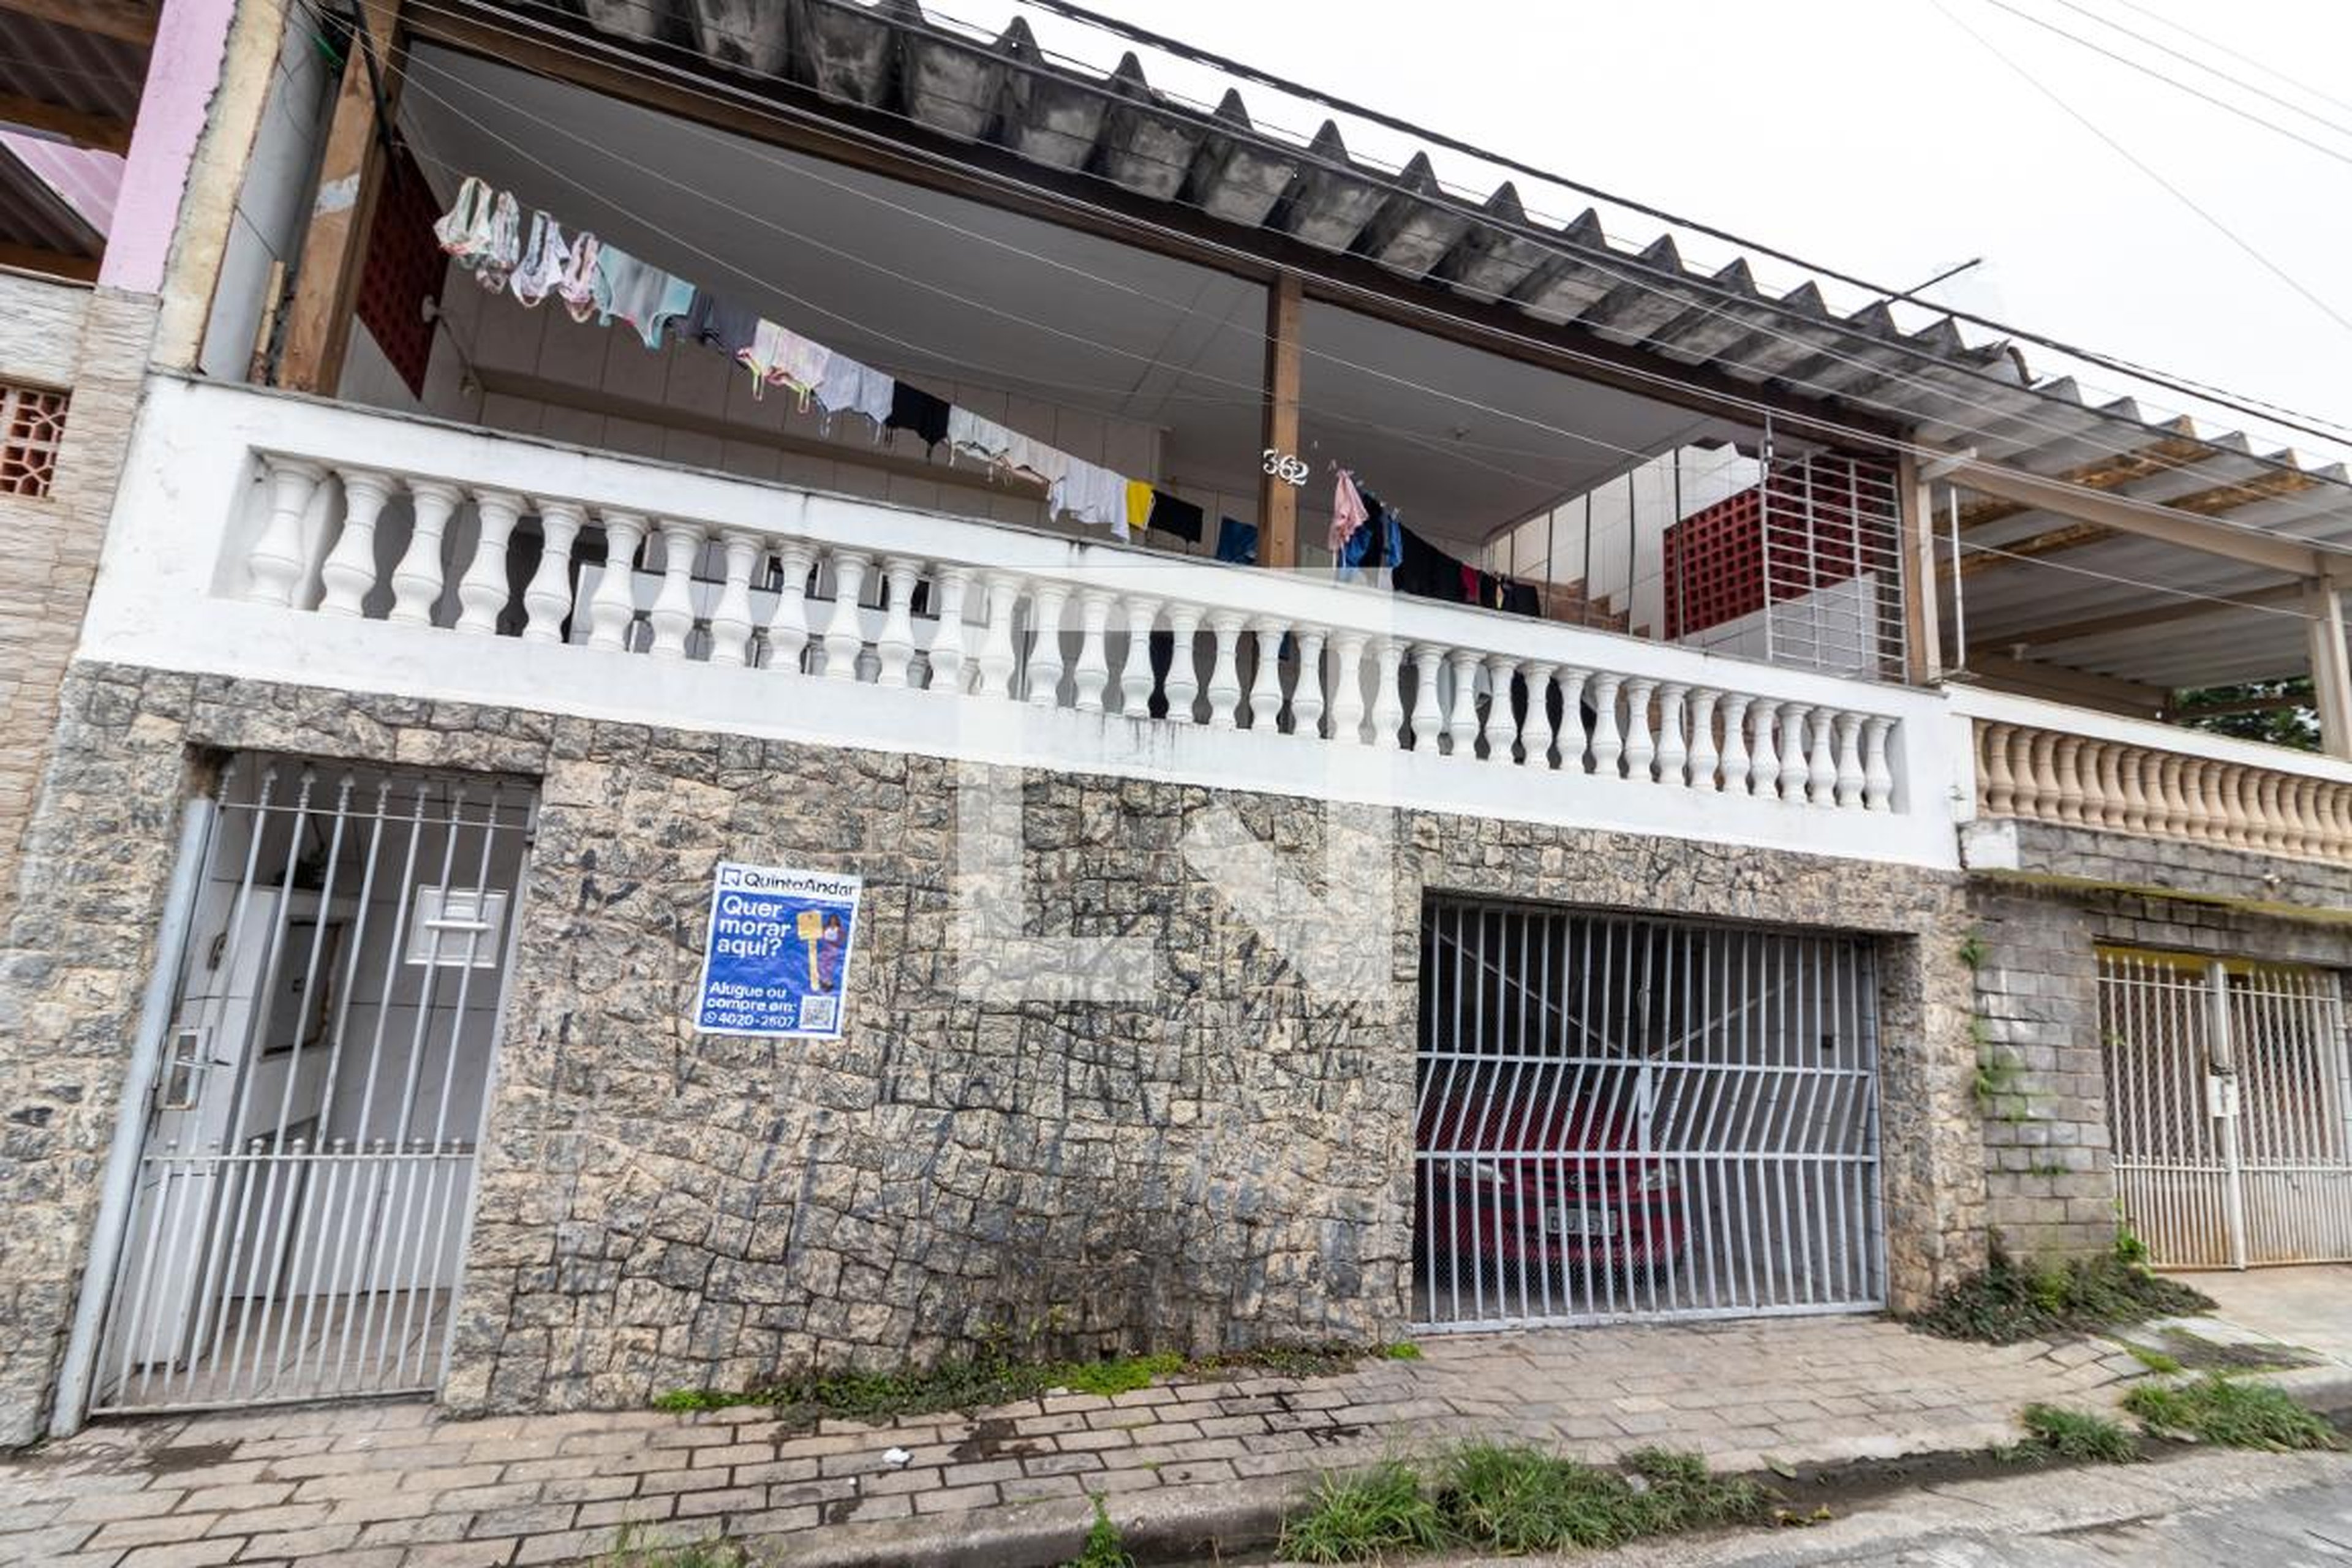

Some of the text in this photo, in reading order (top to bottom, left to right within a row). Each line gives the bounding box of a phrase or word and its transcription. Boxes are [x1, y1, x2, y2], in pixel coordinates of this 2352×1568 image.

[1263, 448, 1310, 485] 362
[744, 873, 854, 895] QuintoAndar
[723, 895, 782, 917] Quer
[719, 919, 791, 937] morar
[717, 937, 782, 958] aqui?
[709, 982, 786, 998] Alugue ou
[706, 998, 766, 1012] compre
